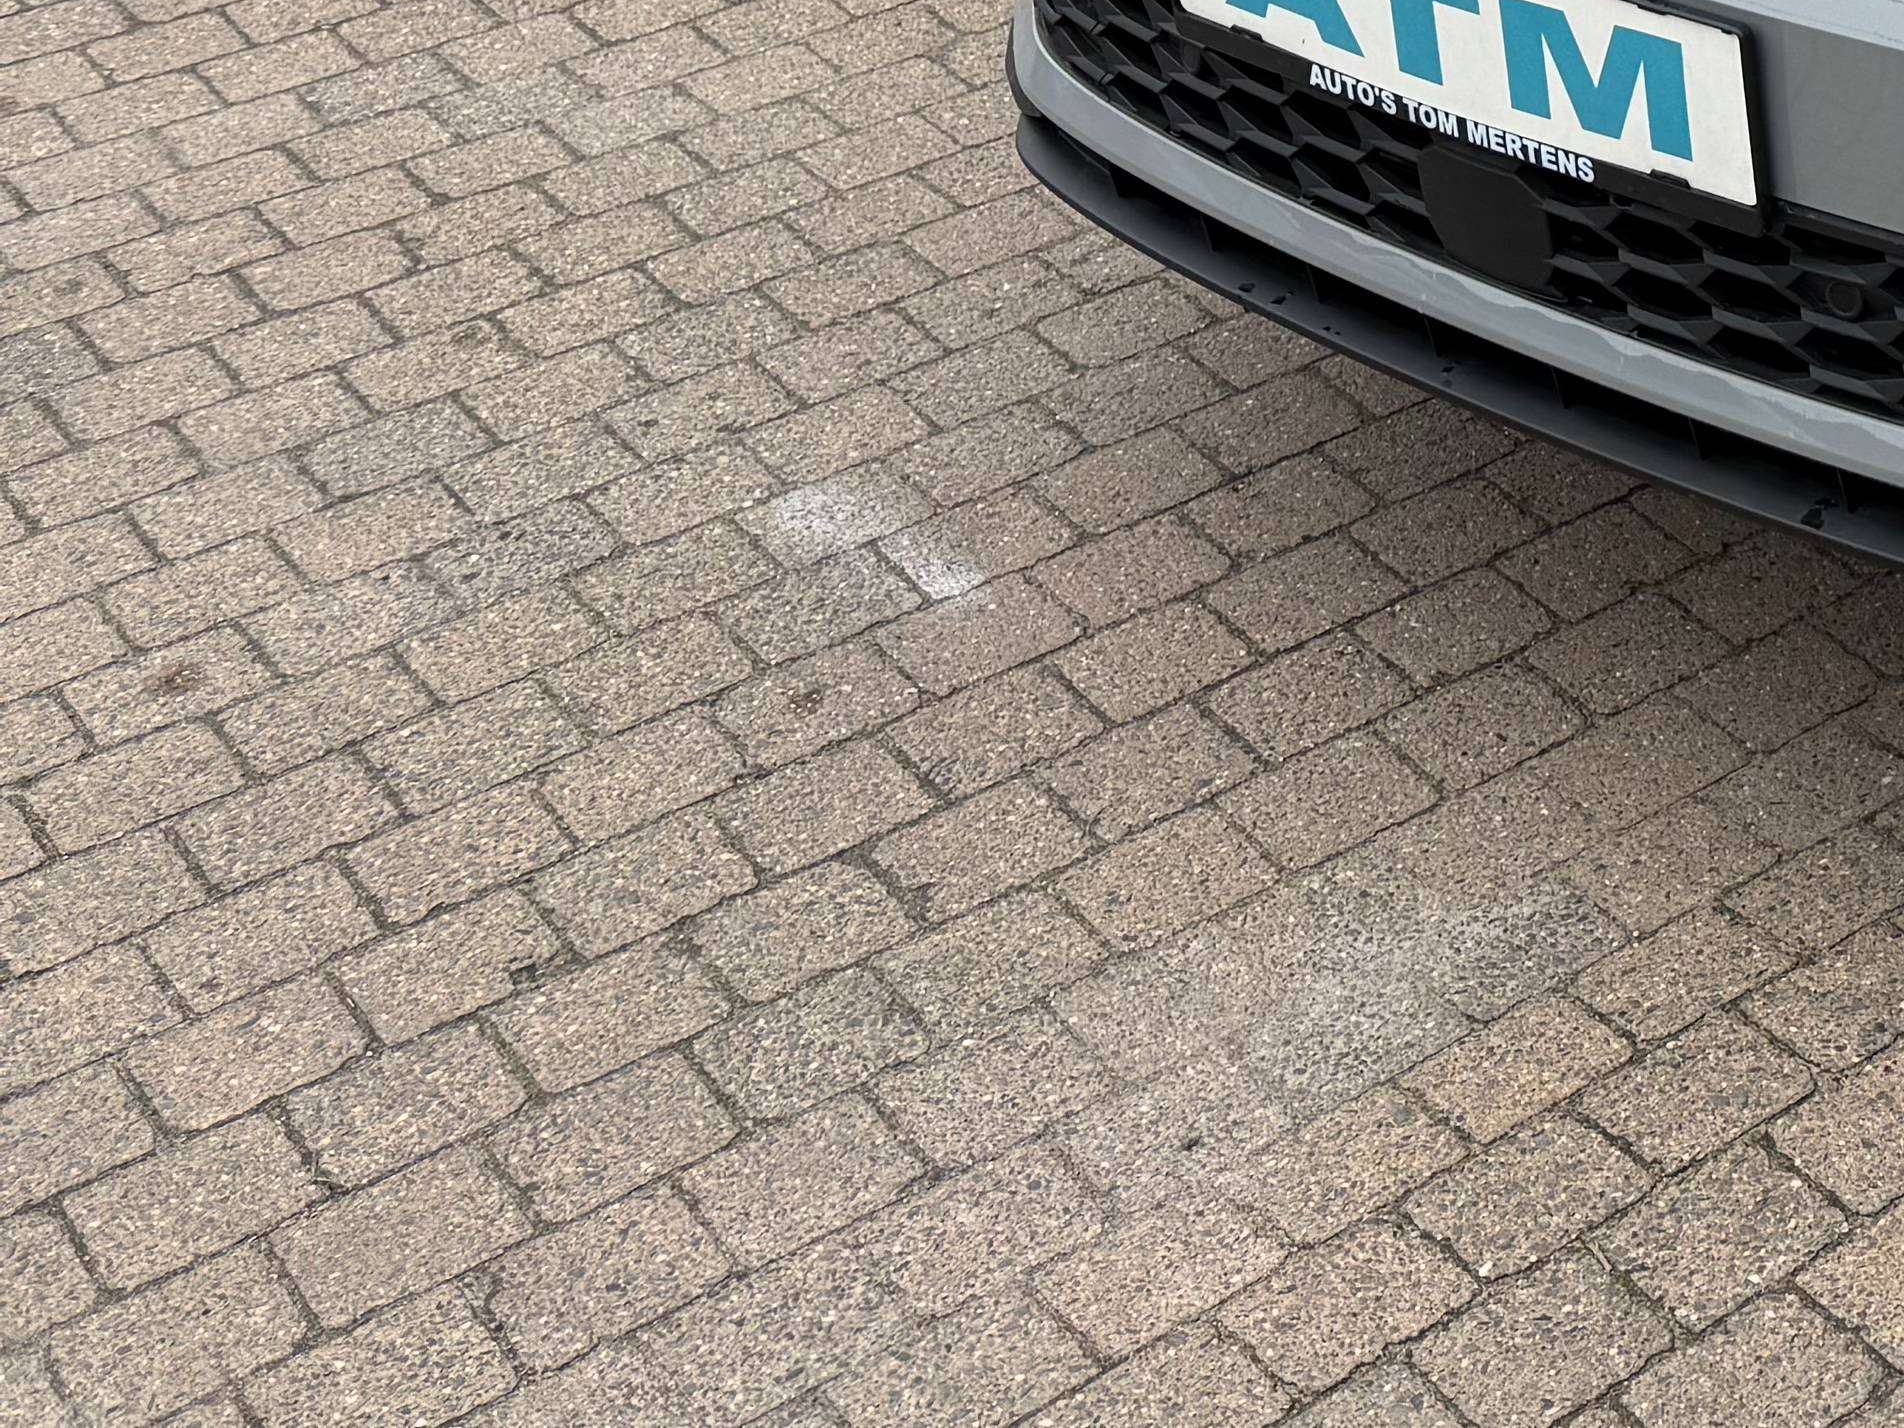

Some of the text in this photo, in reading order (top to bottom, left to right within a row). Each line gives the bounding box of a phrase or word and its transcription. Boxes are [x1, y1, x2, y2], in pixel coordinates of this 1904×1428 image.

[1309, 64, 1596, 184] AUTO'S TOM MERTENS
